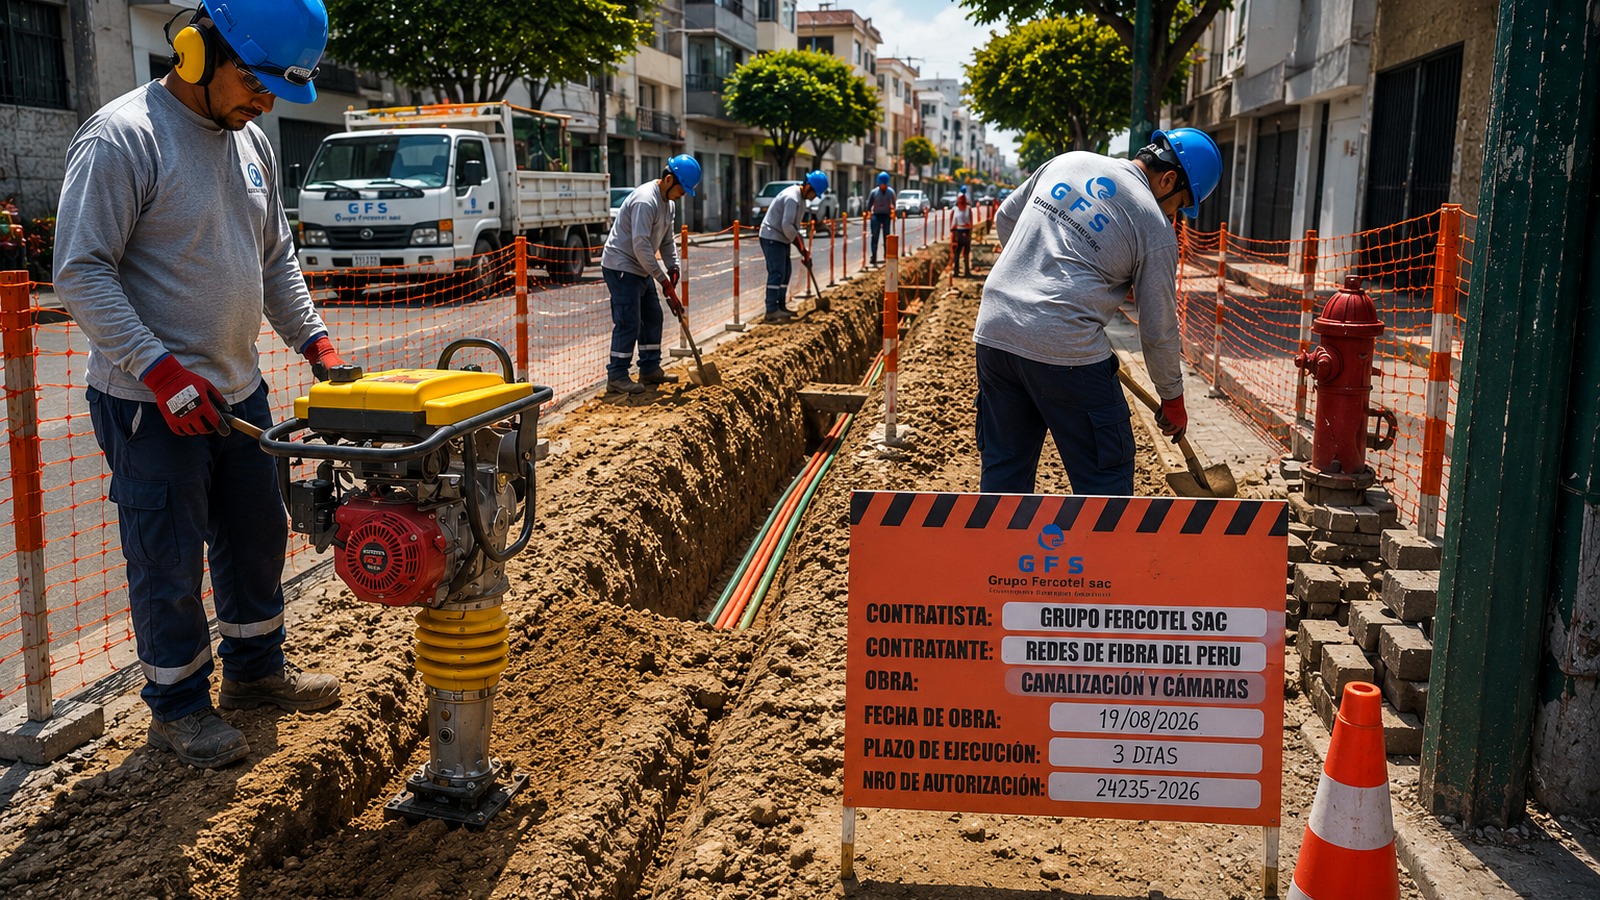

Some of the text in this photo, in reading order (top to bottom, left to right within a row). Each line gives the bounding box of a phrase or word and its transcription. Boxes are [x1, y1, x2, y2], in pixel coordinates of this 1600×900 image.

[988, 575, 1111, 589] Grupo Fercotel sac
[867, 603, 1227, 631] CONTRATISTA: GRUPO FERCOTEL SAC
[866, 637, 1240, 666] CONTRATANTE: REDES DE FIBRA DEL PERU
[866, 670, 1248, 699] OBRA: CANALIZACIÓN Y CÁMARAS
[865, 705, 1198, 733] FECHA DE OBRA: 19/08/2026
[864, 738, 1177, 764] PLAZO DE EJECUCIÓN: 3 DIAS
[863, 771, 1199, 800] NRO DE AUTORIZACIÓN: 24235-2026
